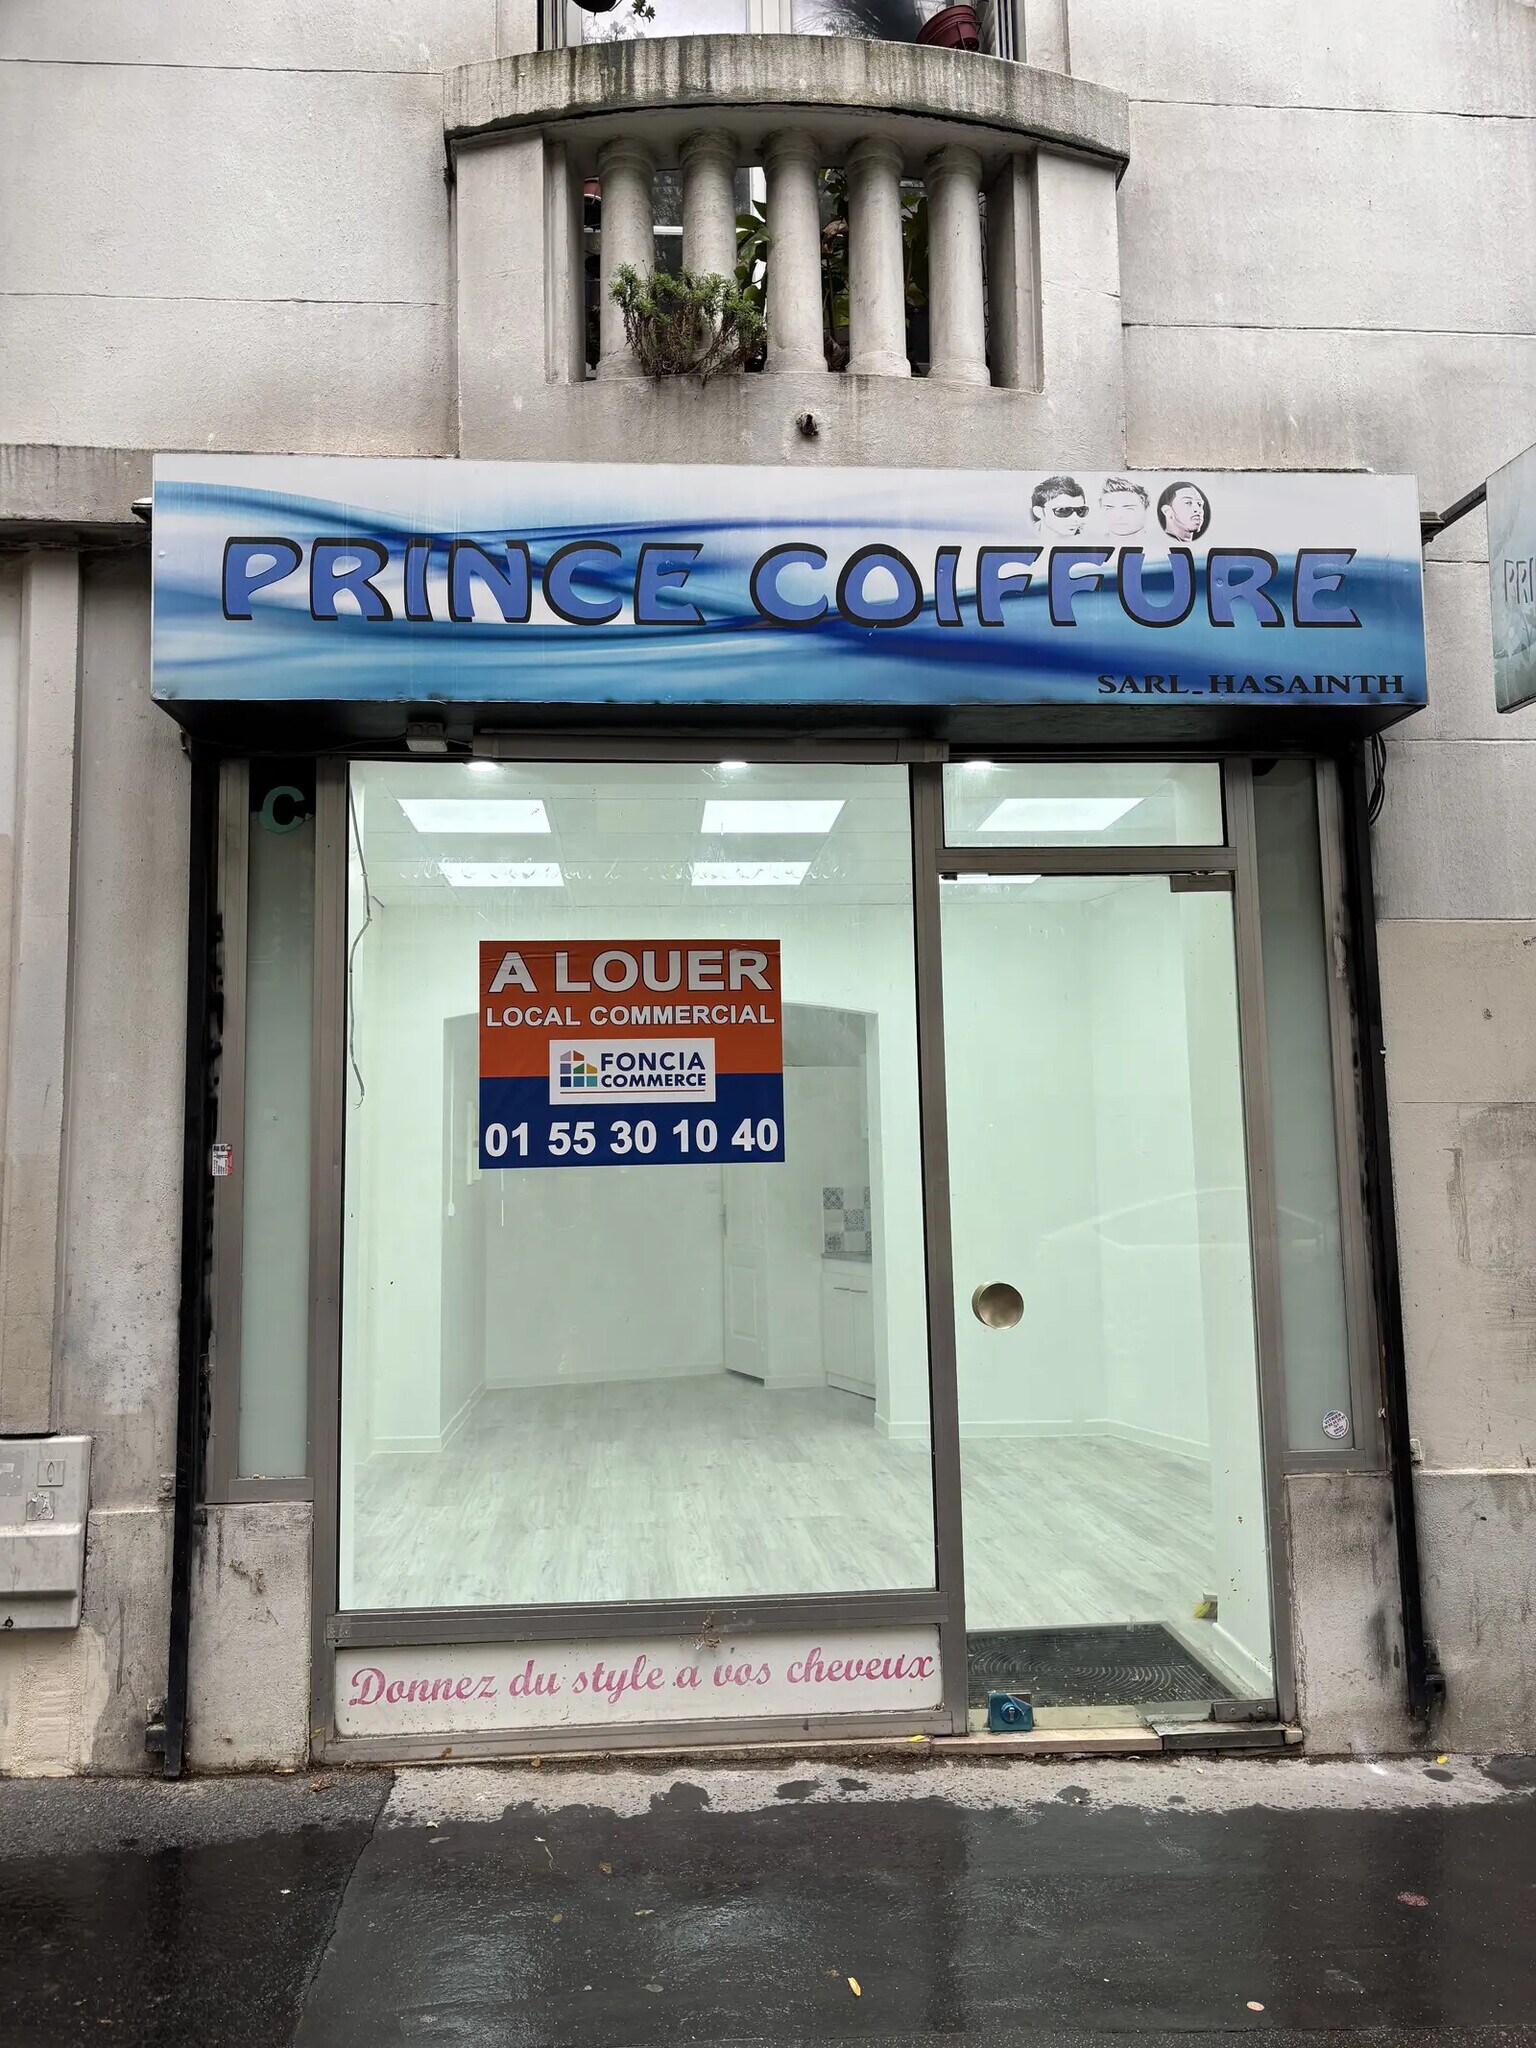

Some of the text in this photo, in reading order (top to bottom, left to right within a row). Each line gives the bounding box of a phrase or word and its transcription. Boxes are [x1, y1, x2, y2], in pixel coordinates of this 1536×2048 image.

[222, 536, 1363, 629] PRINCE COIFFURE
[488, 949, 773, 993] A LOUER
[485, 1004, 775, 1027] LOCAL COMMERCIAL
[600, 1052, 706, 1072] FONCIA
[600, 1072, 706, 1088] COMMERCE
[484, 1118, 779, 1157] 01 55 30 10 40
[348, 1667, 498, 1706] Donnez
[509, 1659, 561, 1697] du
[571, 1654, 664, 1704] style
[713, 1662, 772, 1687] vos
[786, 1647, 935, 1684] cheveux
